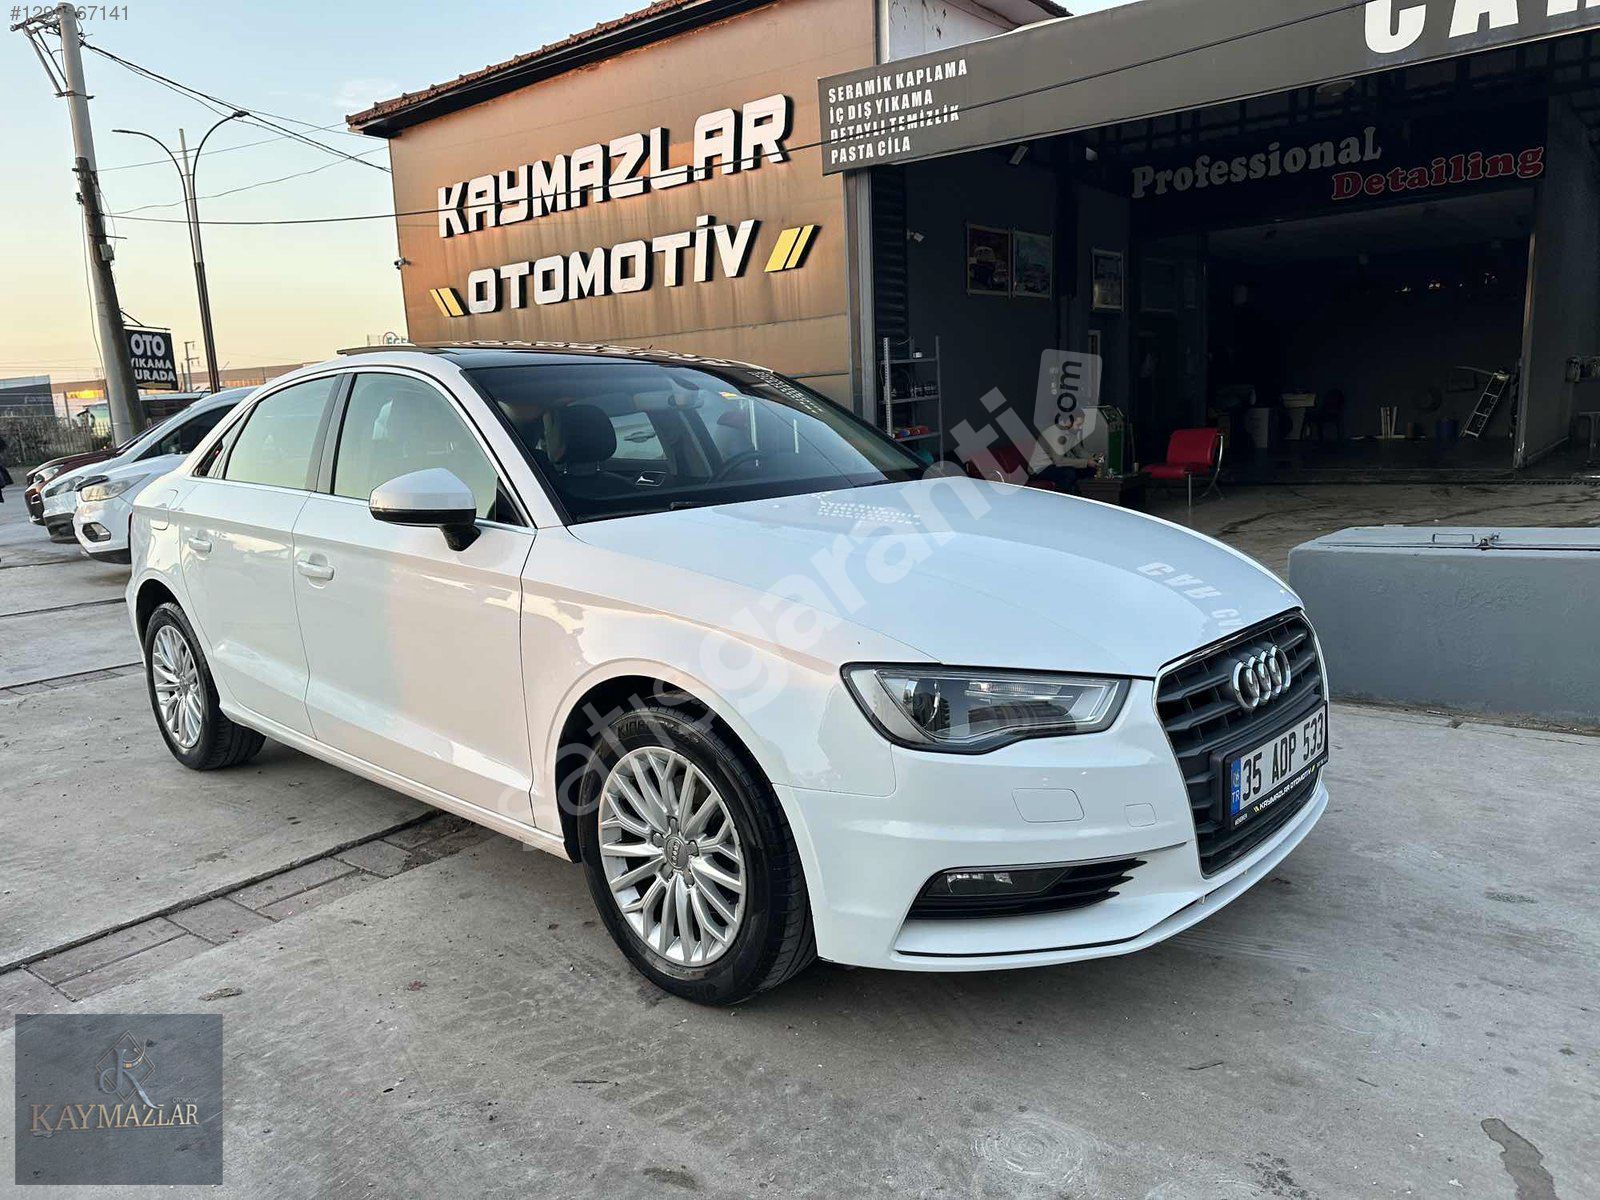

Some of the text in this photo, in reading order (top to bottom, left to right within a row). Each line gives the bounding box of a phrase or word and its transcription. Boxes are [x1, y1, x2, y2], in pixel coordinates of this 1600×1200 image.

[828, 58, 968, 104] SERAMİK KAPLAMA
[829, 89, 934, 125] İÇ DIŞ YIKAMA
[830, 104, 960, 144] DETAYLI TEMİZLİK
[438, 93, 789, 239] KAYMAZLAR
[831, 136, 912, 165] PASTA CİLA
[1331, 146, 1545, 200] Detailing
[467, 214, 758, 315] OTOMOTİV
[130, 333, 166, 357] OTO
[134, 369, 176, 382] URADA
[1231, 712, 1324, 803] TR 35 ADP 533
